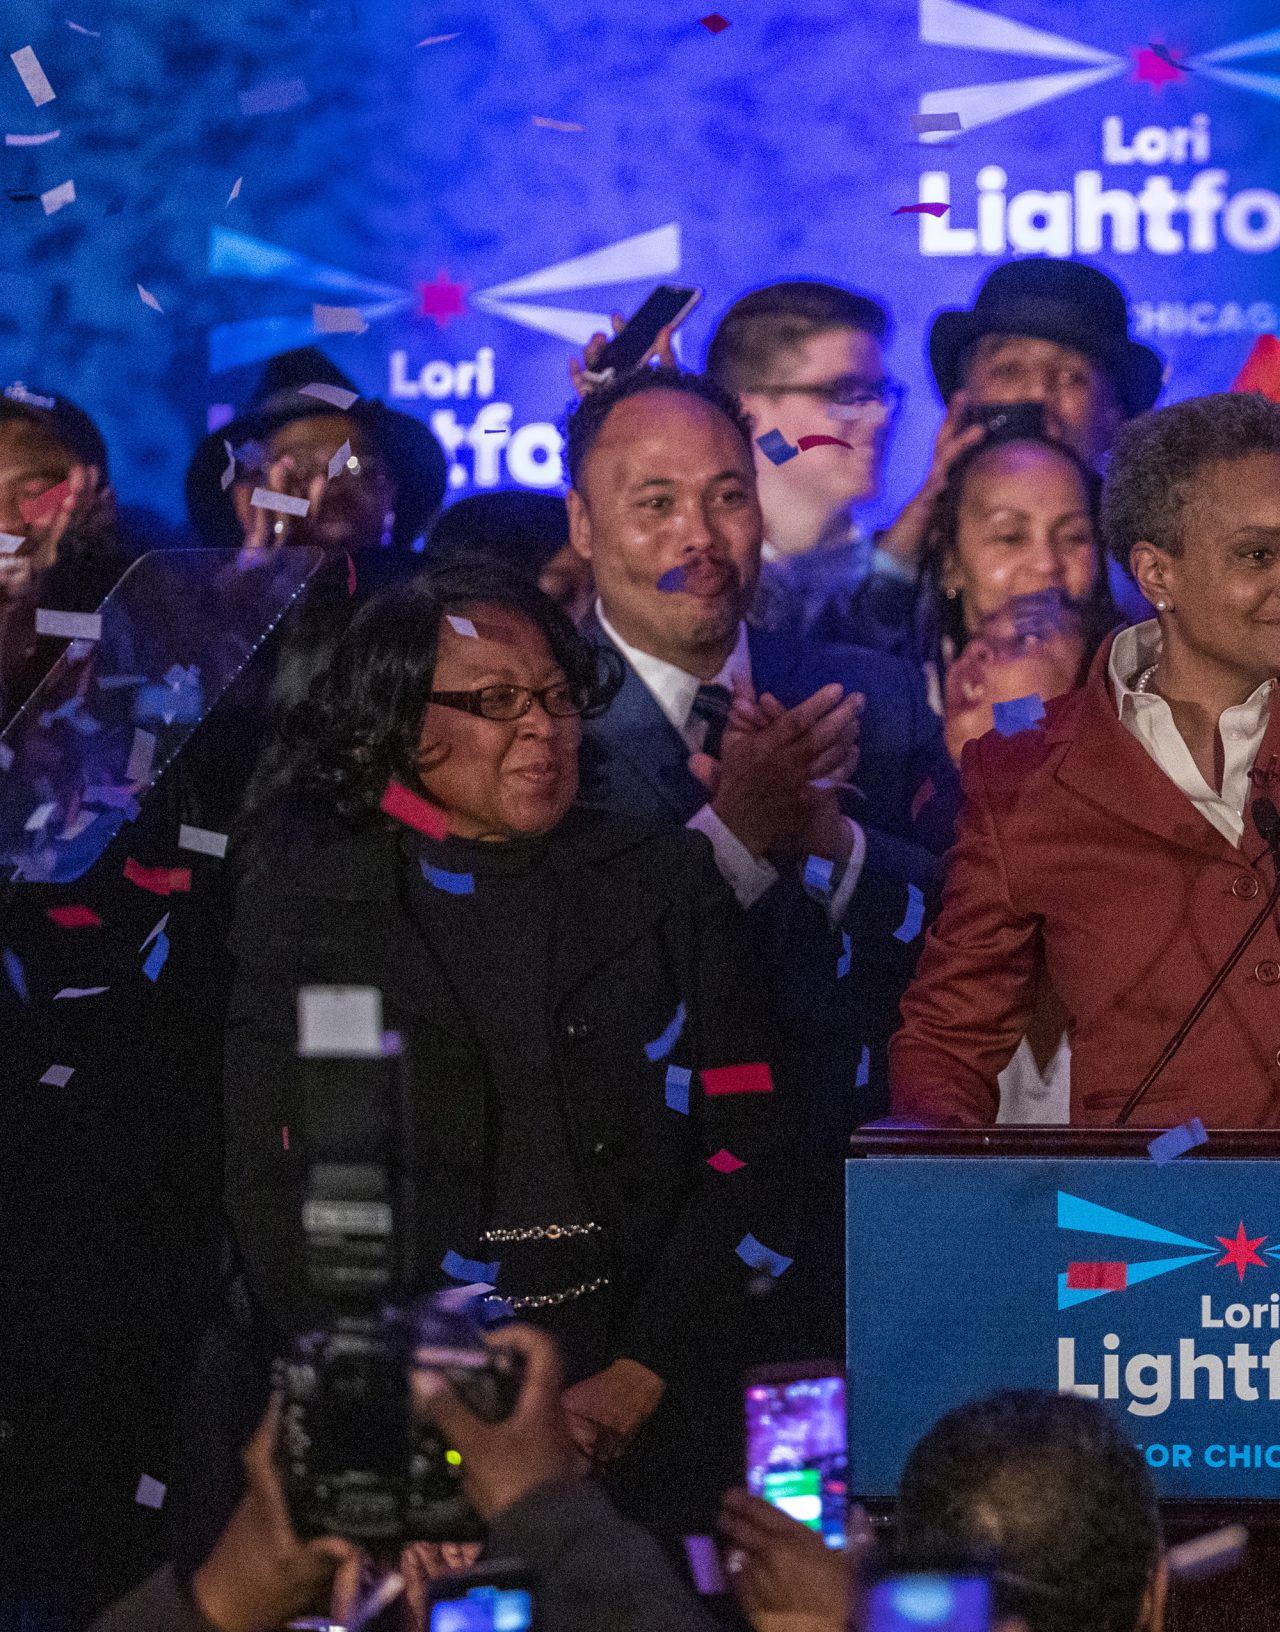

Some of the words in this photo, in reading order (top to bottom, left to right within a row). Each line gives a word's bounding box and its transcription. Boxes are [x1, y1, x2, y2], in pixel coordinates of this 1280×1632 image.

[1103, 114, 1209, 165] Lori
[389, 346, 495, 399] Lori
[1201, 1292, 1280, 1329] Lori
[1136, 1443, 1193, 1468] OR
